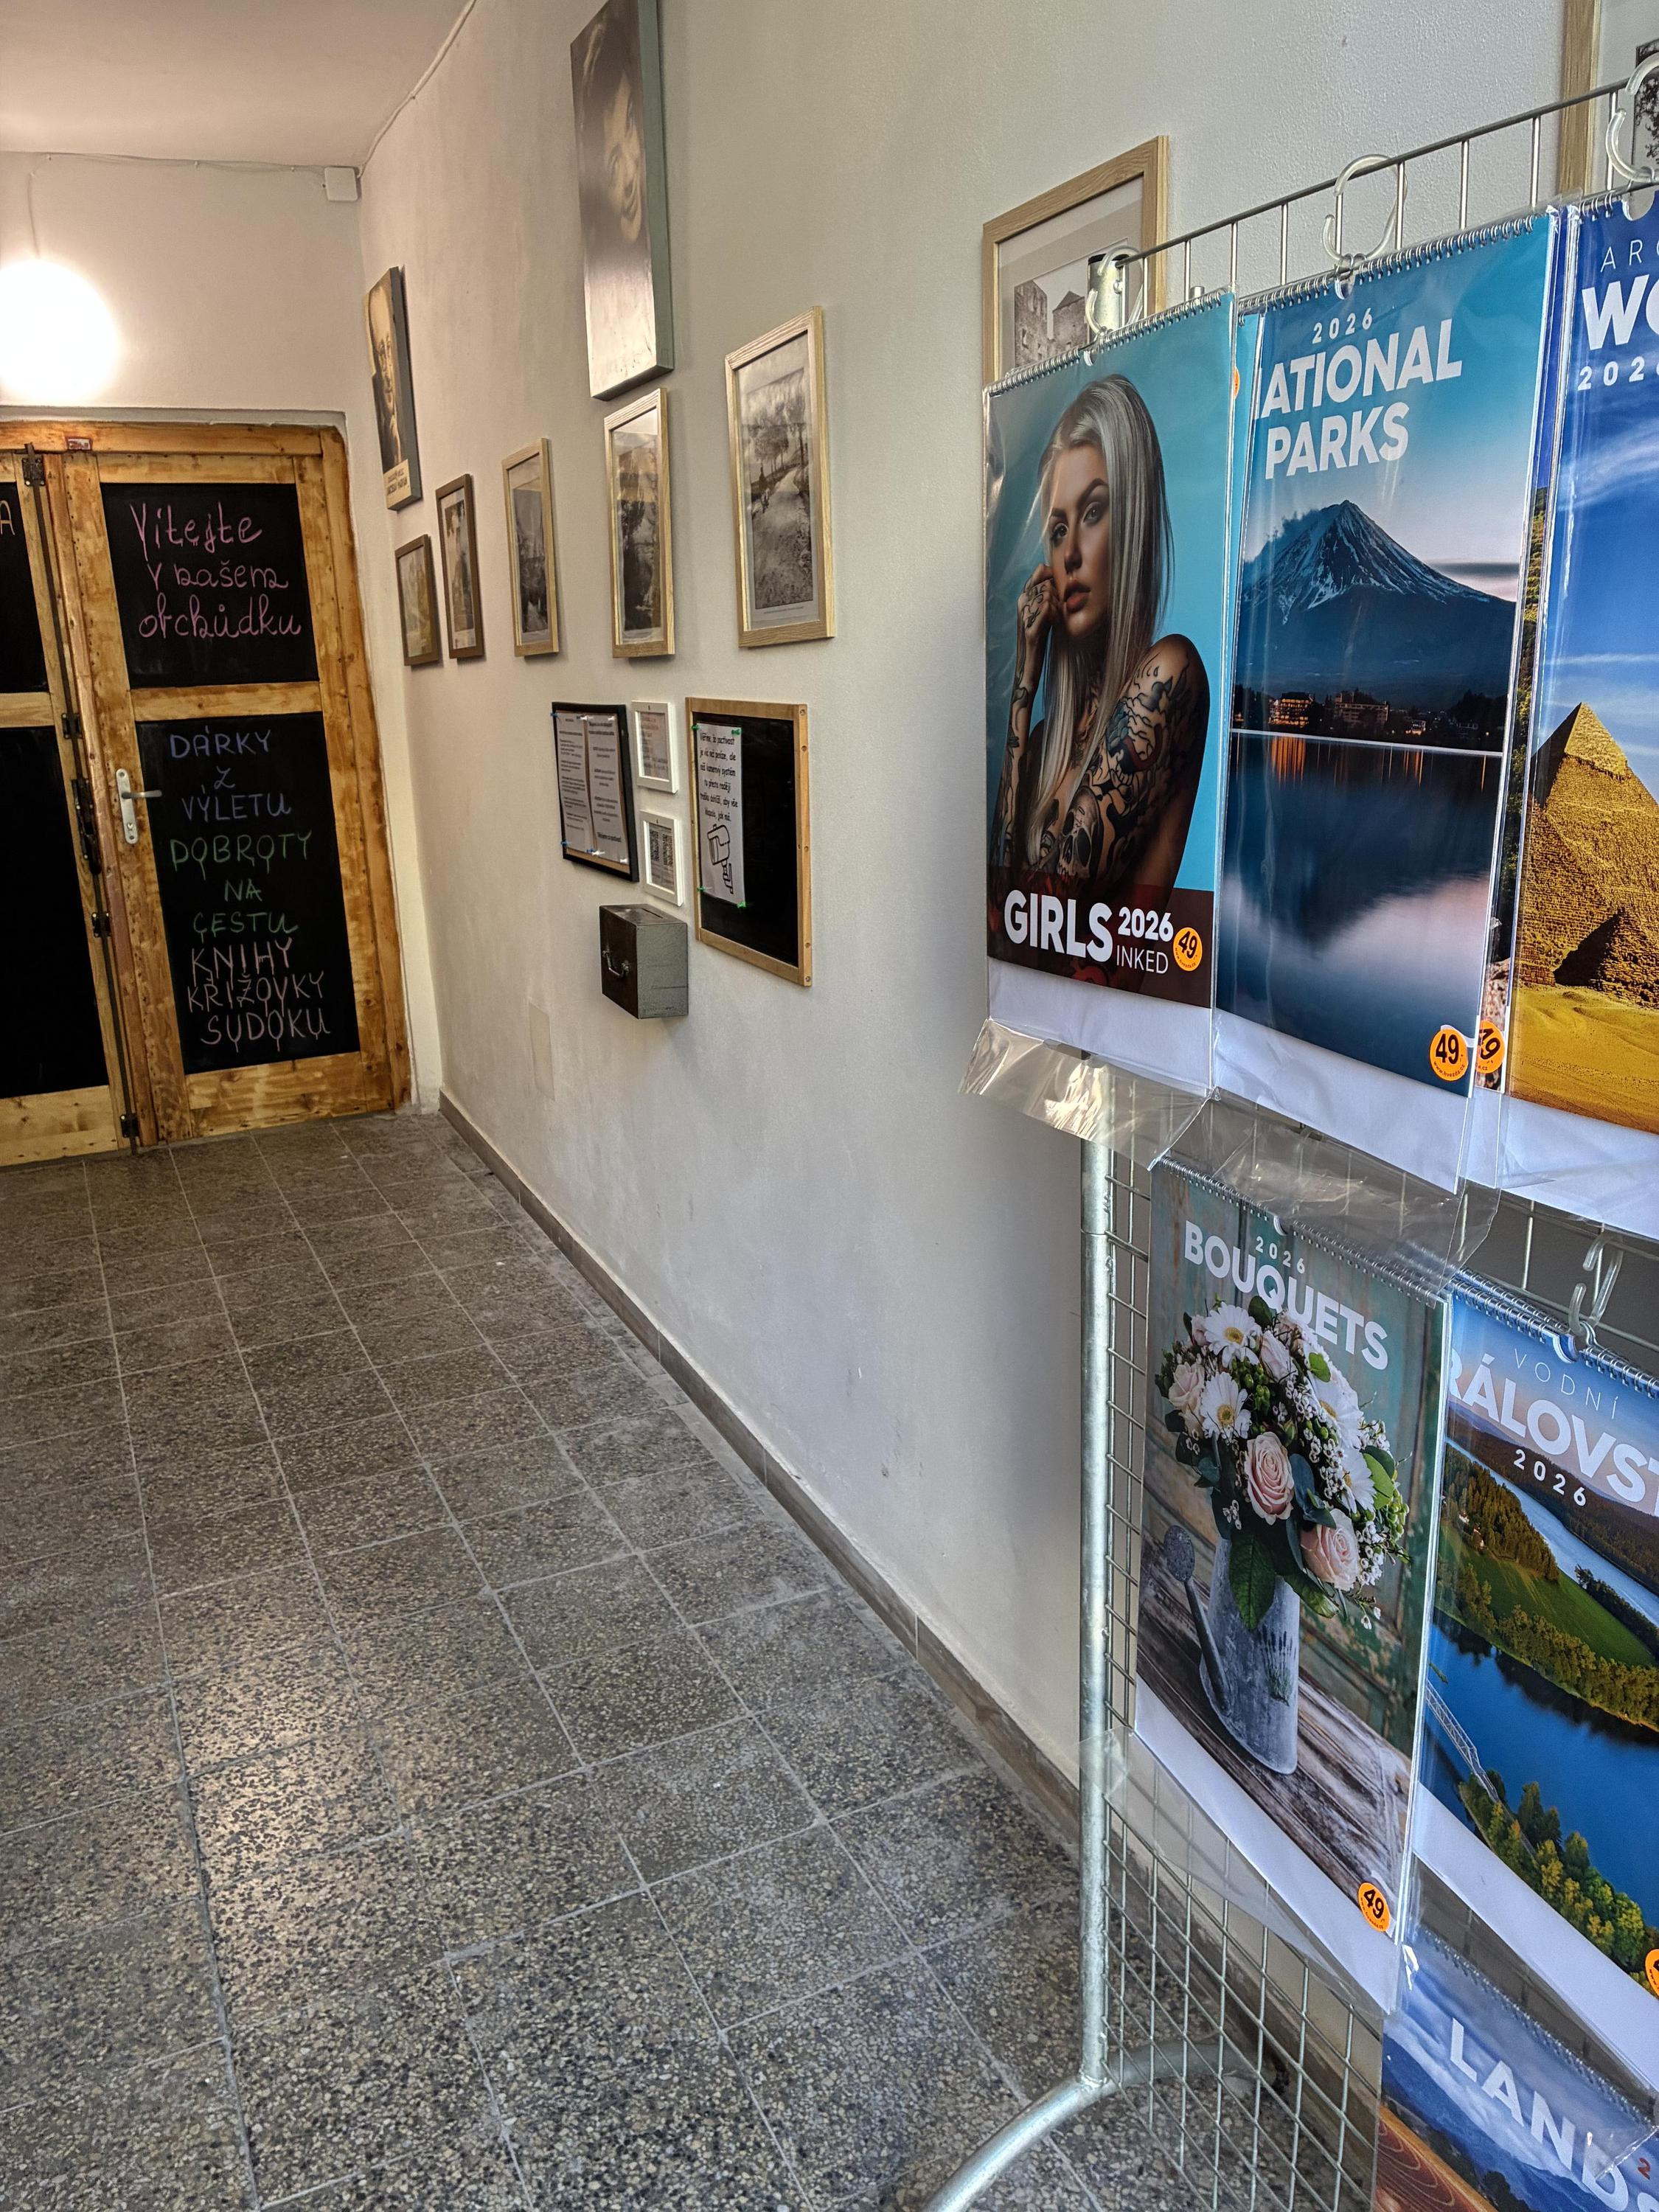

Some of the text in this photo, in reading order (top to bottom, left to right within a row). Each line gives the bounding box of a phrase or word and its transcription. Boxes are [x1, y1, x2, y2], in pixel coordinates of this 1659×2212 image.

[1600, 239, 1659, 273] AR
[1312, 307, 1373, 344] 2026
[1260, 319, 1463, 420] ATIONAL
[1577, 356, 1659, 391] 202
[1265, 401, 1410, 480] PARKS
[173, 560, 289, 588] našem
[139, 593, 302, 639] obchůdku
[170, 725, 271, 759] DÁRKY
[181, 784, 292, 823] VÝLETU
[170, 830, 312, 877] DOBROTY
[223, 879, 262, 902] NA
[193, 911, 299, 942] CESTU
[1004, 889, 1174, 962] GIRLS 2026
[192, 936, 293, 989] KNIHY
[1116, 945, 1169, 974] INKED
[1178, 931, 1197, 959] 49
[201, 1007, 330, 1052] SUDOKU
[1436, 1033, 1459, 1064] 49
[1256, 1236, 1306, 1273] 2026
[1184, 1220, 1388, 1369] BOUQUETS
[1514, 1348, 1618, 1419] VODNÍ
[1514, 1449, 1587, 1506] 2026
[1363, 1889, 1384, 1919] 49
[1450, 2017, 1659, 2212] LAND
